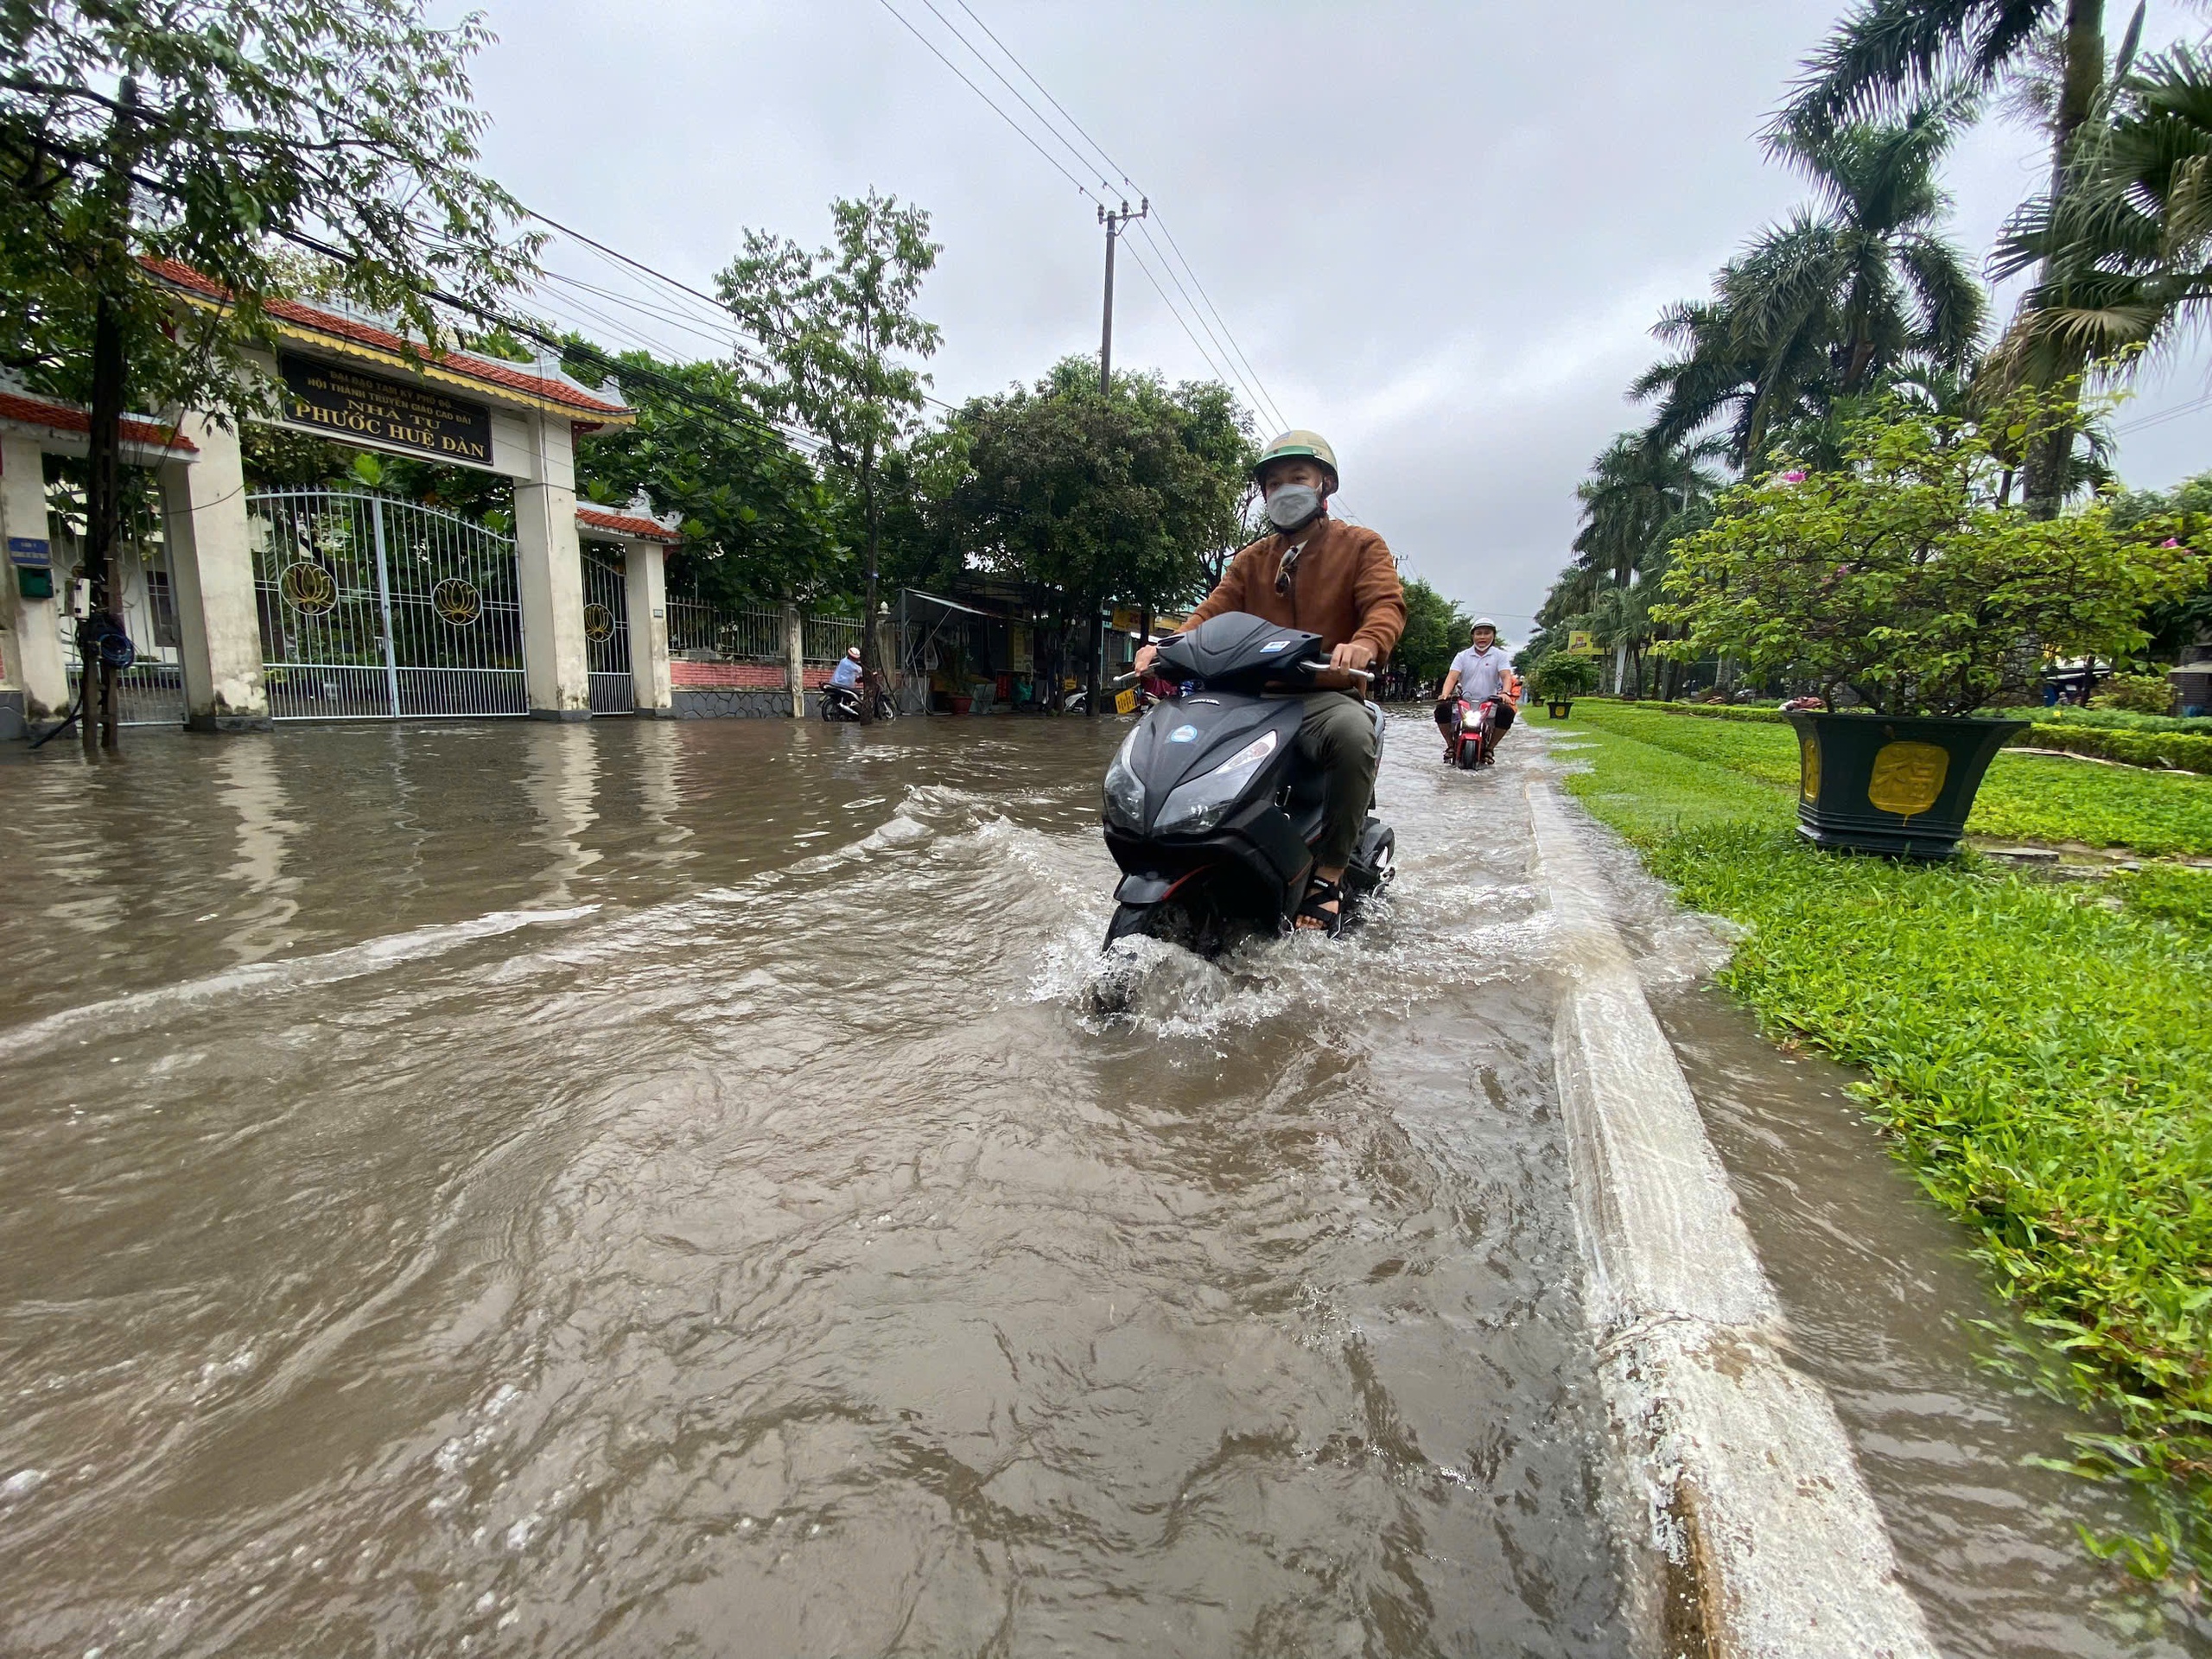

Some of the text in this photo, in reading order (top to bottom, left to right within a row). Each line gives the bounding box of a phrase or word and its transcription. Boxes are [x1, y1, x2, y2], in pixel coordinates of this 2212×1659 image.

[346, 398, 442, 429] NHÀ TU
[435, 409, 454, 421] CAO
[295, 404, 485, 458] PHƯỚC HUỆ ĐÀN
